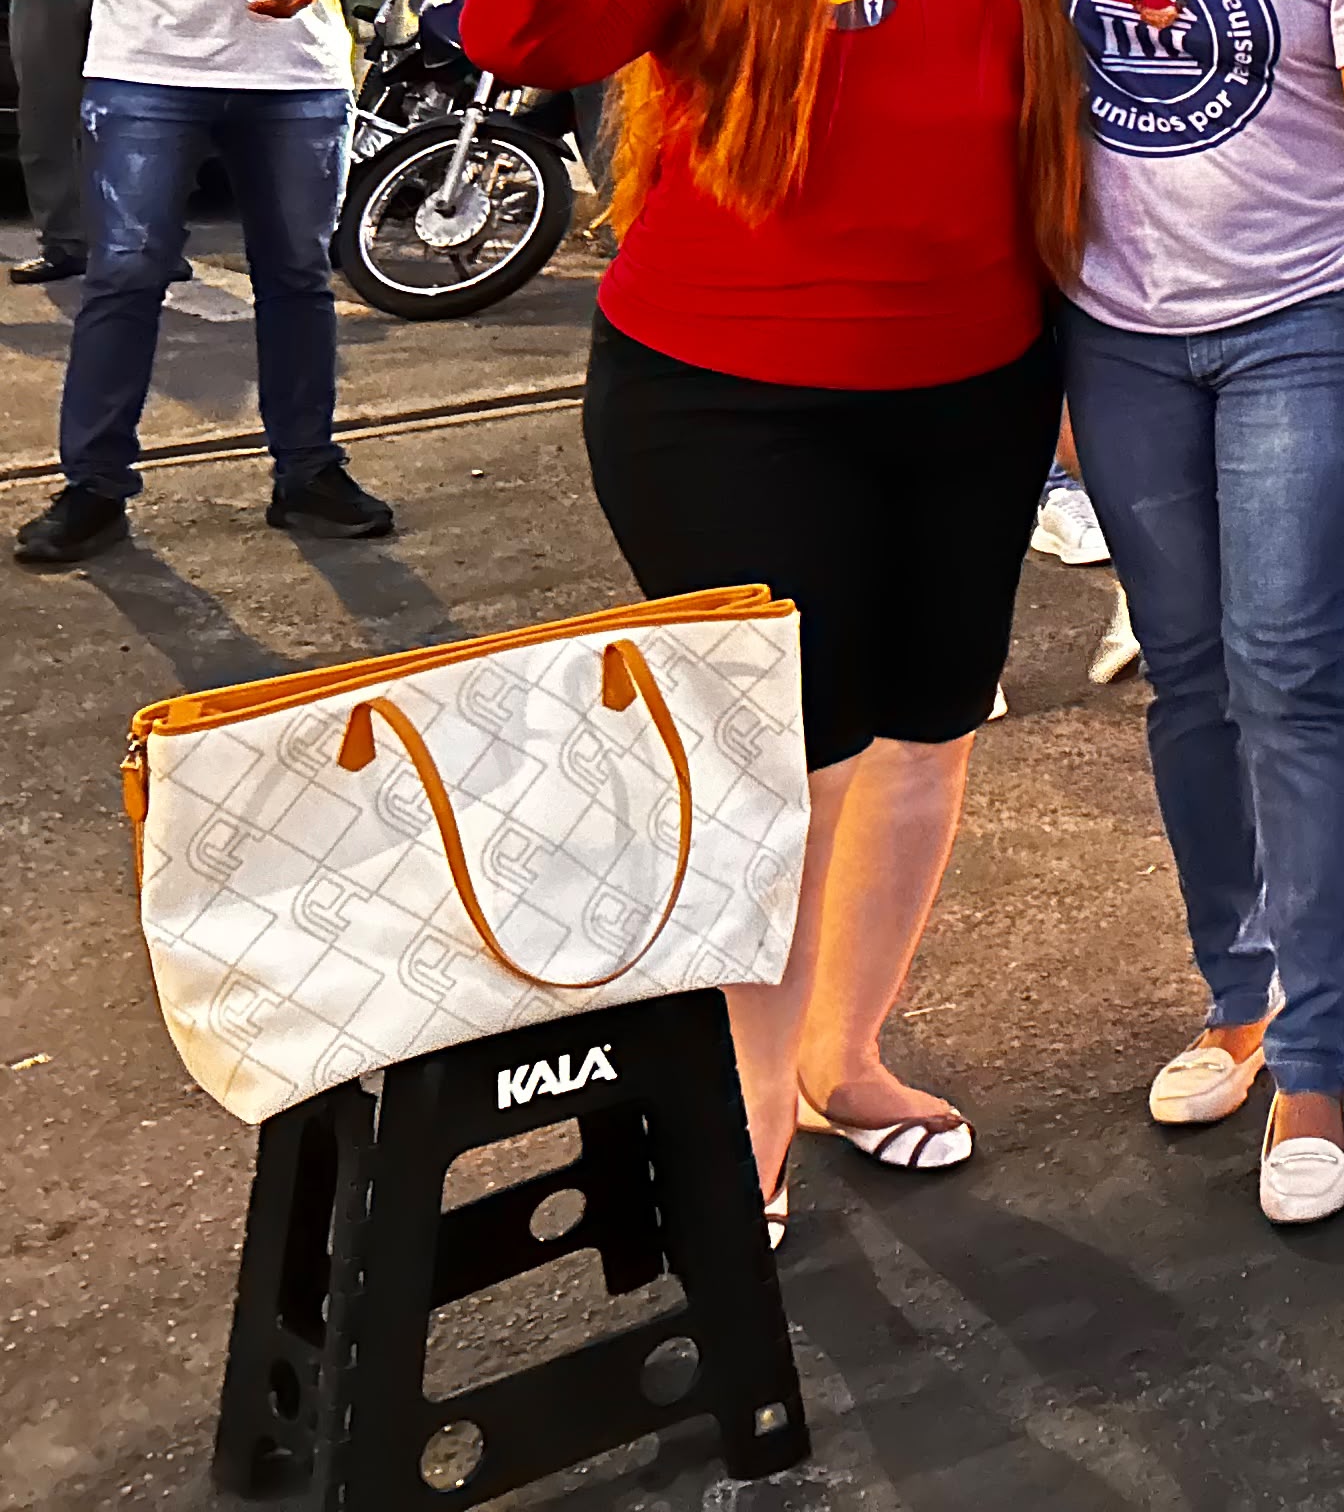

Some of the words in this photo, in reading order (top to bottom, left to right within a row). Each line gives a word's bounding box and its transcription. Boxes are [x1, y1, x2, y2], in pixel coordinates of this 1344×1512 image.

[1091, 95, 1187, 134] unidos
[1188, 89, 1233, 133] por
[497, 1045, 618, 1109] KALA
